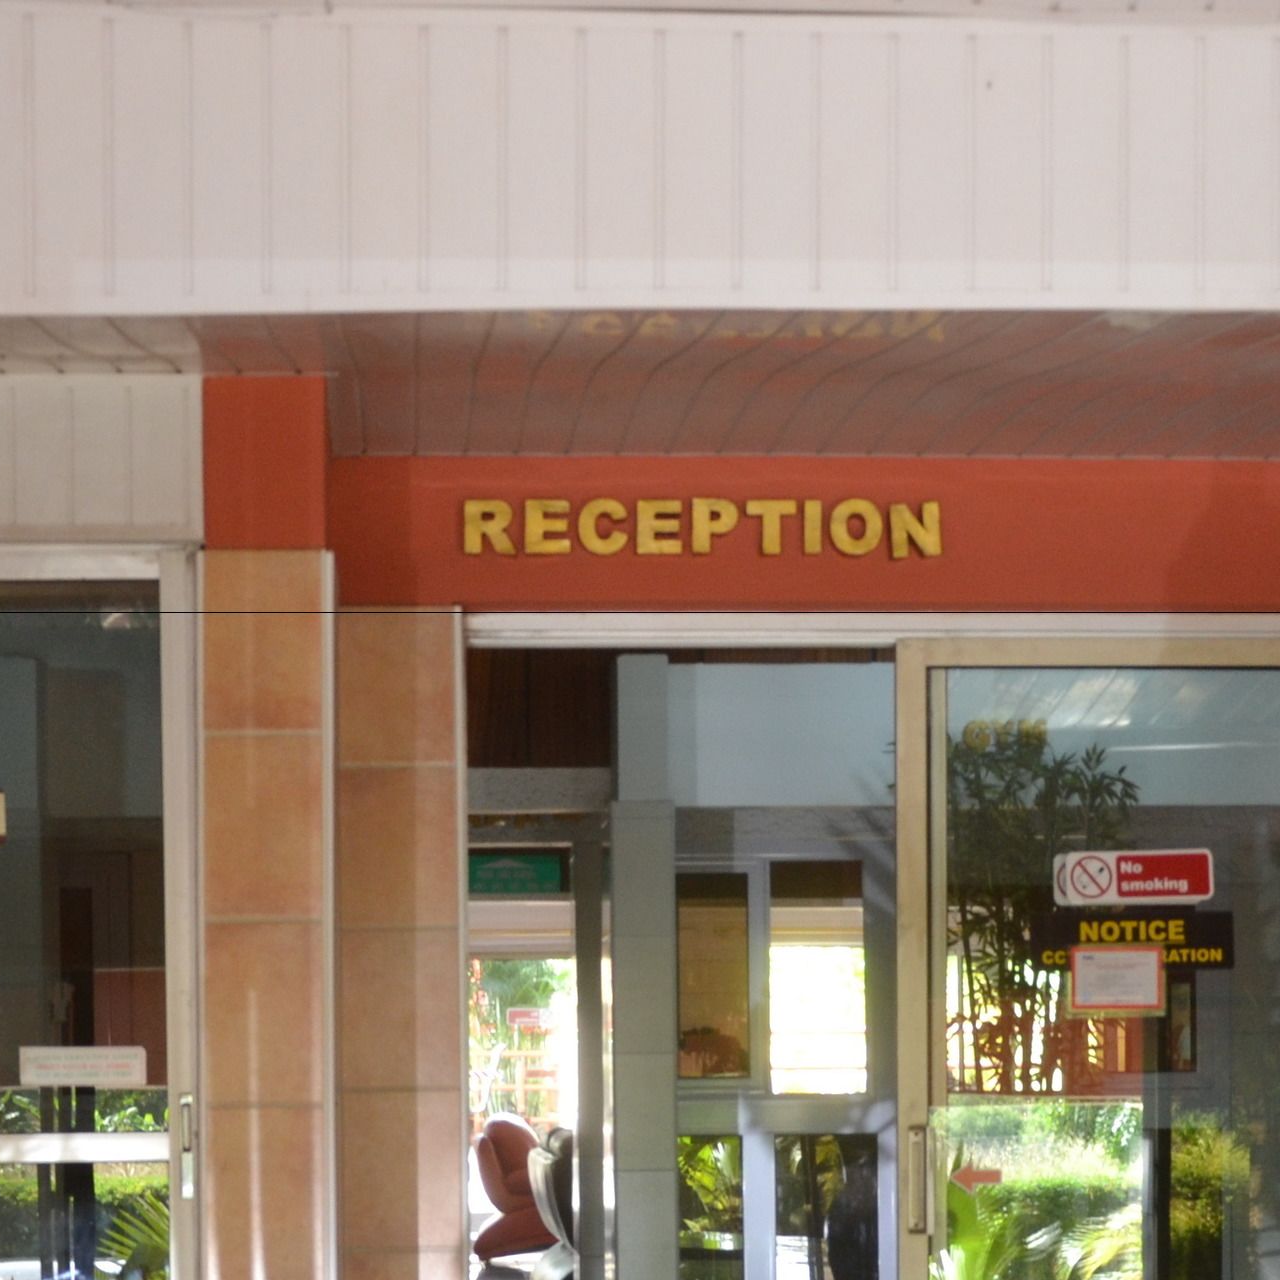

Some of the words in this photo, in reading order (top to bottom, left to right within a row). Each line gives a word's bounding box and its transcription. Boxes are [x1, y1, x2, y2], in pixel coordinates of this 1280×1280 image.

[463, 498, 943, 560] RECEPTION
[1120, 860, 1143, 875] No
[1120, 877, 1189, 893] smoking
[1079, 919, 1186, 943] NOTICE
